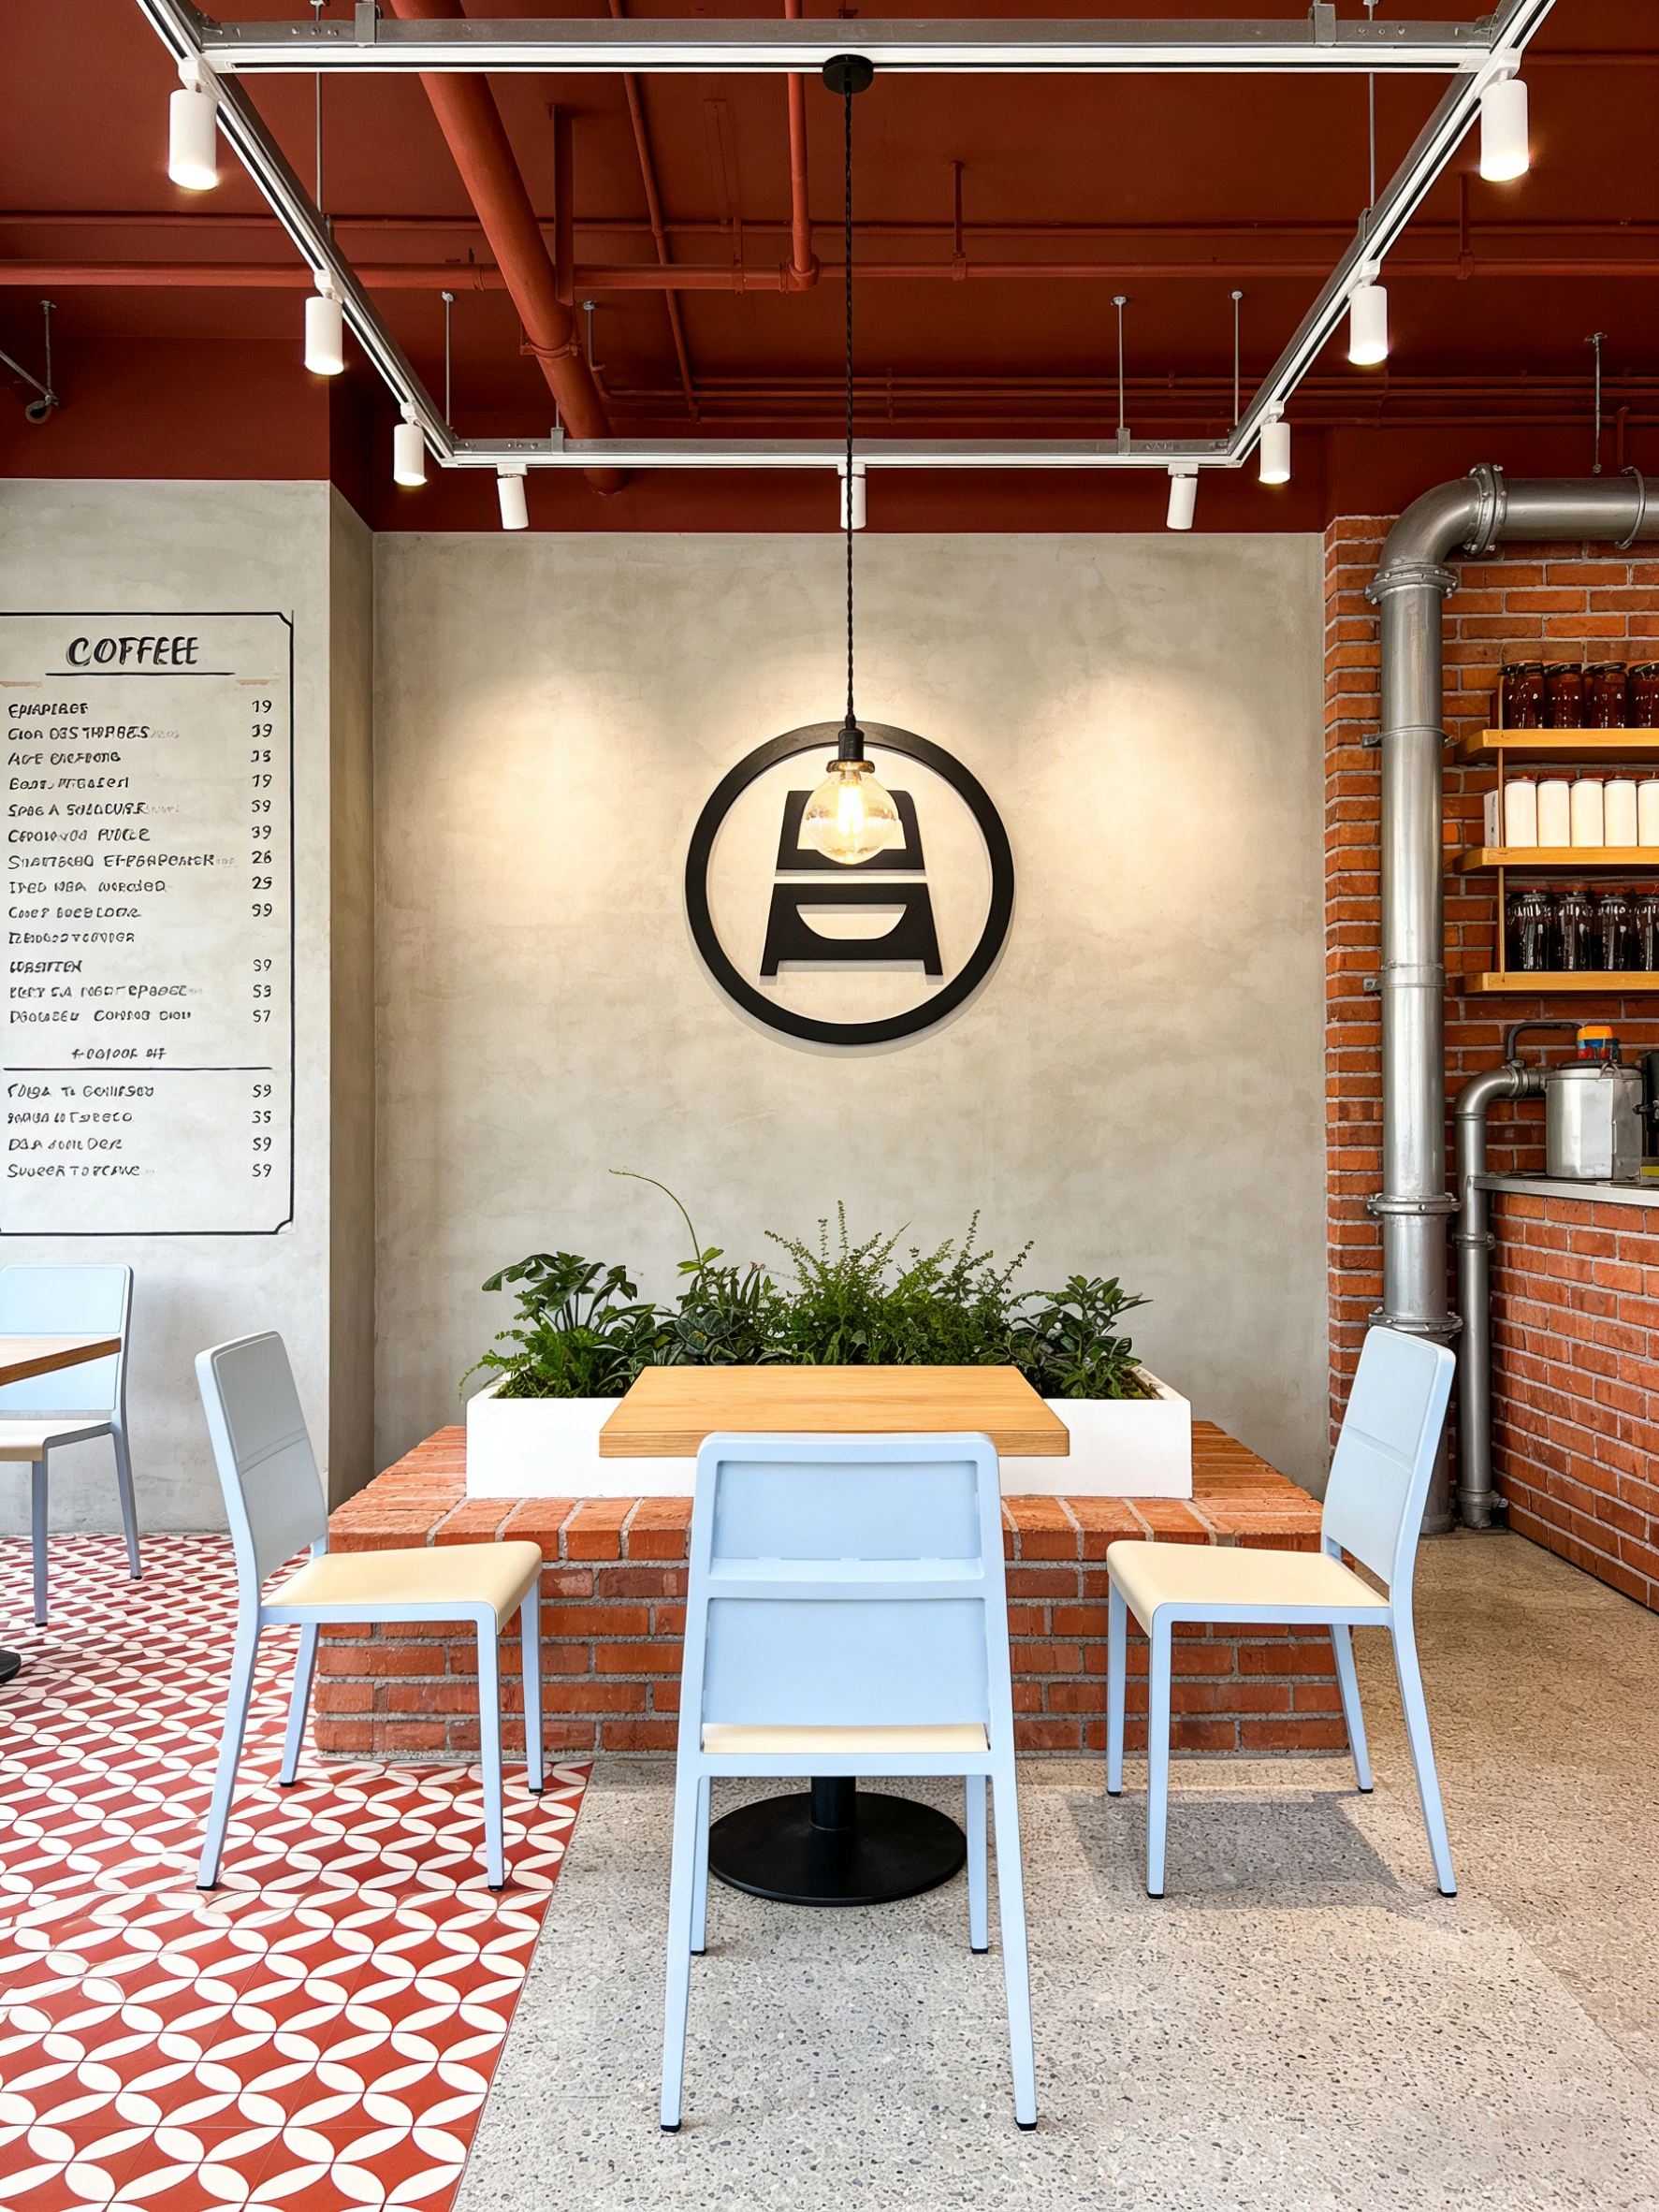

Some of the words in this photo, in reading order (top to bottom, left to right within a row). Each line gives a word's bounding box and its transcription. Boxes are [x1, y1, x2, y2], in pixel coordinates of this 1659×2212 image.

[252, 699, 272, 714] 19
[48, 803, 60, 816] A
[251, 824, 272, 840] 39
[251, 850, 272, 865] 26
